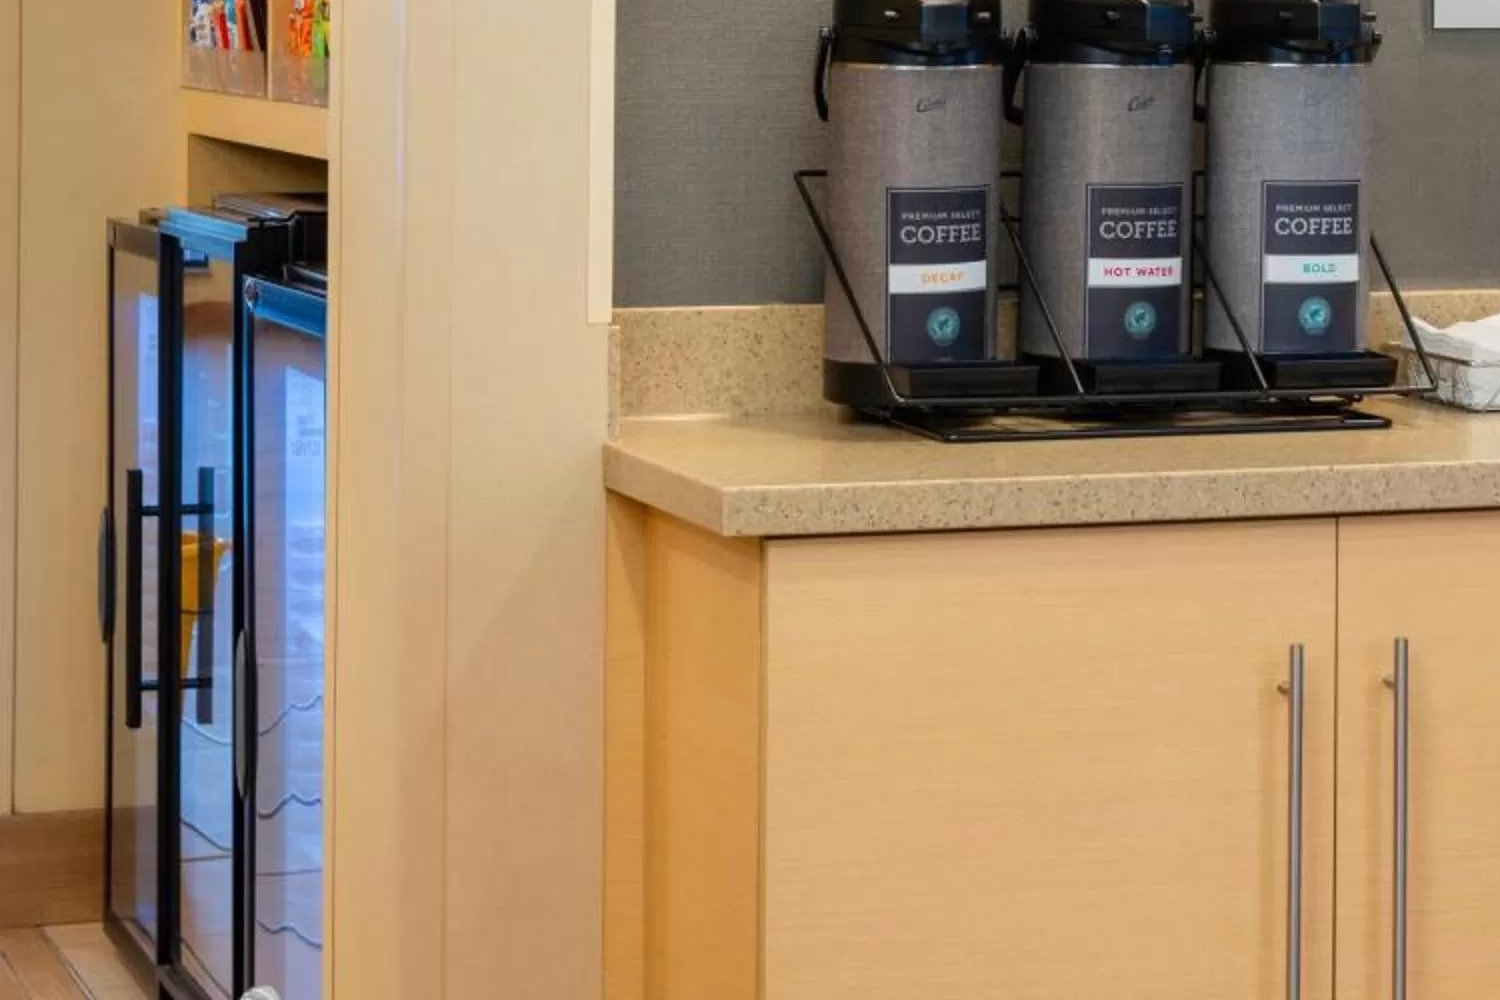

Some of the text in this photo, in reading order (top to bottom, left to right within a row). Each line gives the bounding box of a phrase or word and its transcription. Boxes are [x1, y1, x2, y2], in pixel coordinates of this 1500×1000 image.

[900, 223, 981, 243] COFFEE
[1099, 220, 1177, 239] COFFEE
[1274, 217, 1353, 235] COFFEE
[1103, 267, 1174, 277] HOT WATER
[1302, 263, 1336, 273] BOLD
[921, 272, 964, 285] DECAF
